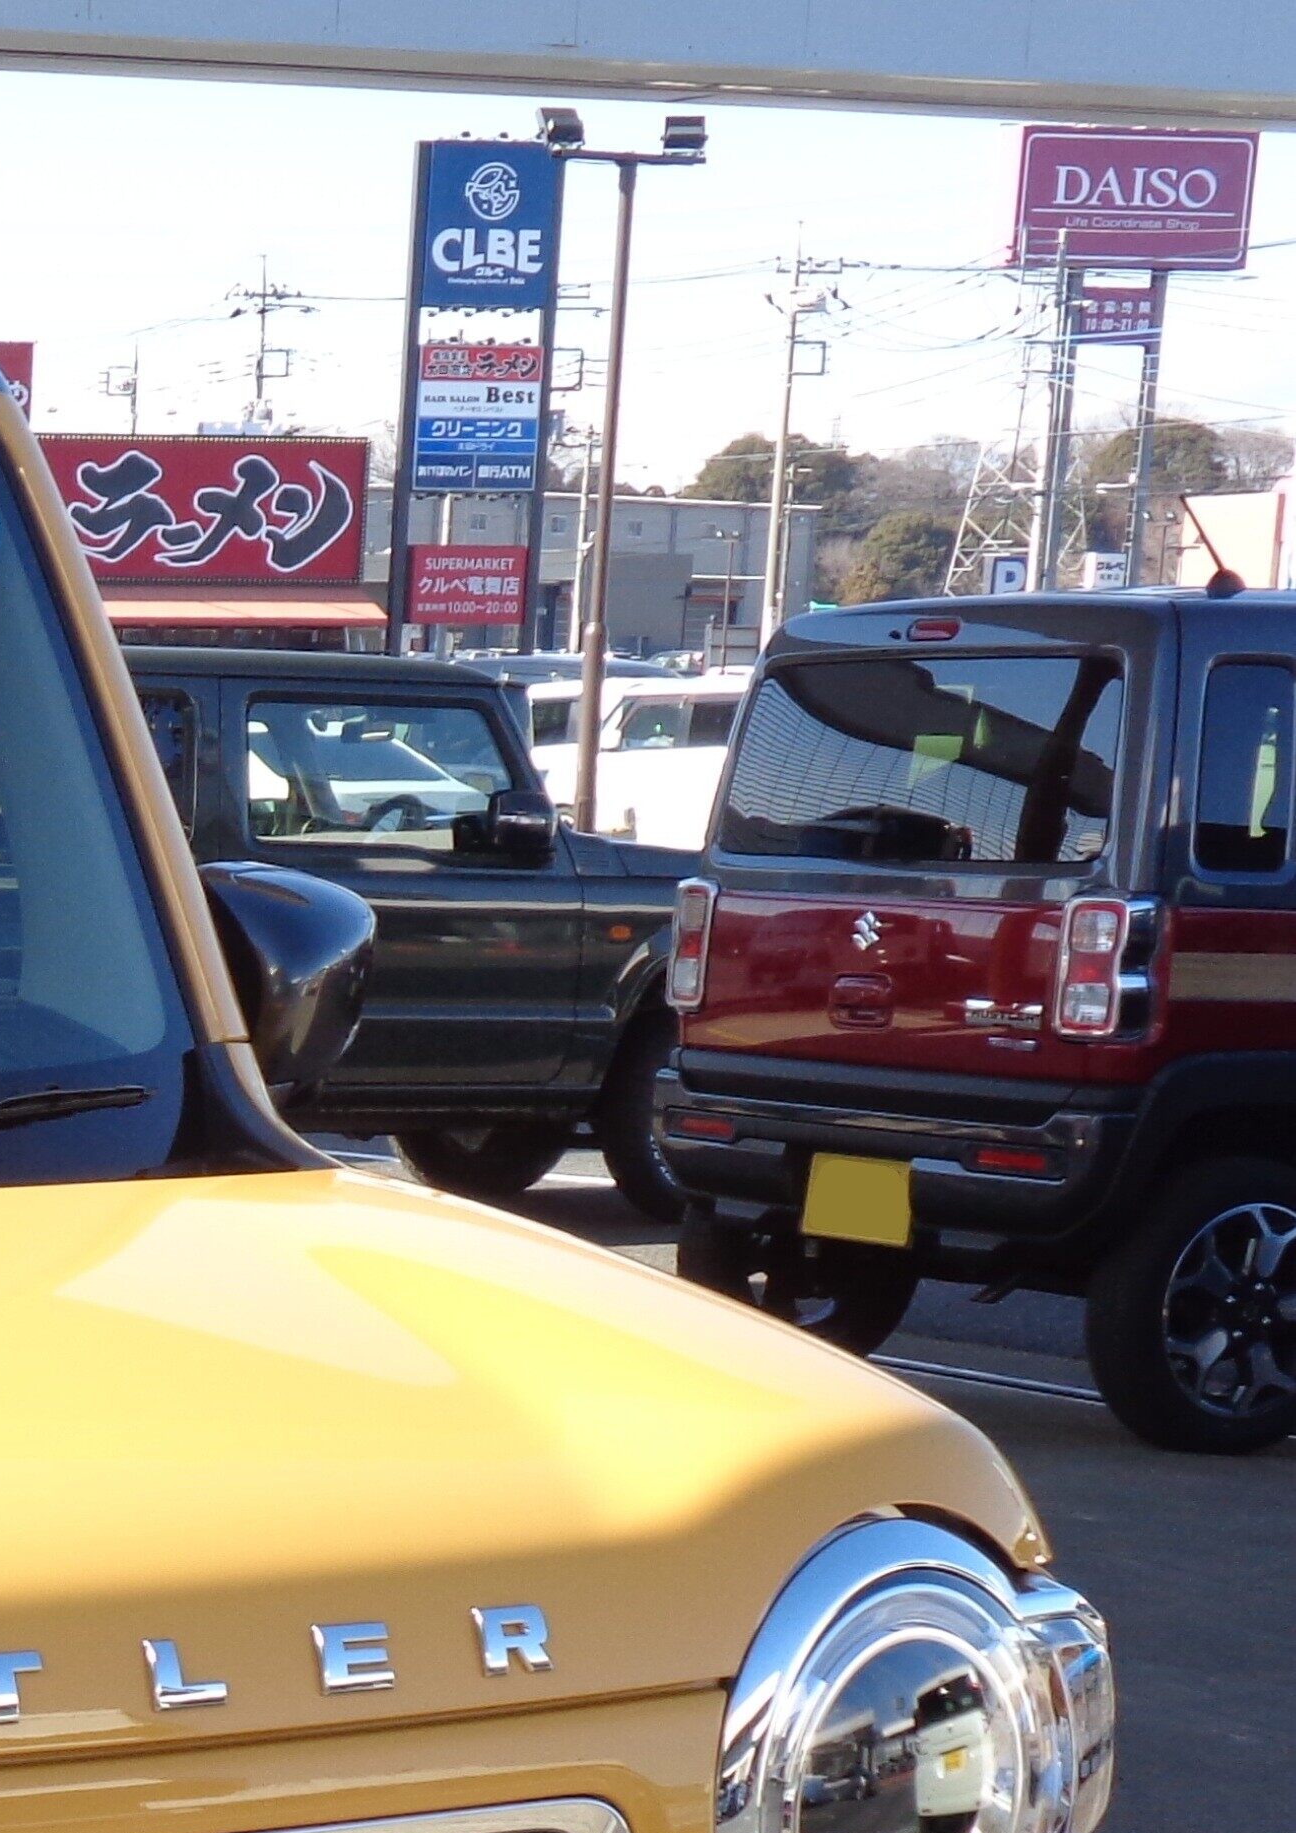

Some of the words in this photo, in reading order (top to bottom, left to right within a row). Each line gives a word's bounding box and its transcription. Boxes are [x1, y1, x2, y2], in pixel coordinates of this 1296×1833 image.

[1052, 164, 1218, 210] DAISO
[1065, 216, 1088, 227] Life
[1091, 216, 1163, 228] Coordinate
[1166, 218, 1200, 231] Shop
[432, 228, 544, 274] CLBE
[476, 351, 539, 379] ラーメン
[486, 386, 535, 404] Best
[67, 449, 354, 573] ラーメン
[425, 557, 515, 571] SUPERMARKET
[418, 575, 520, 596] クルベ竜舞店
